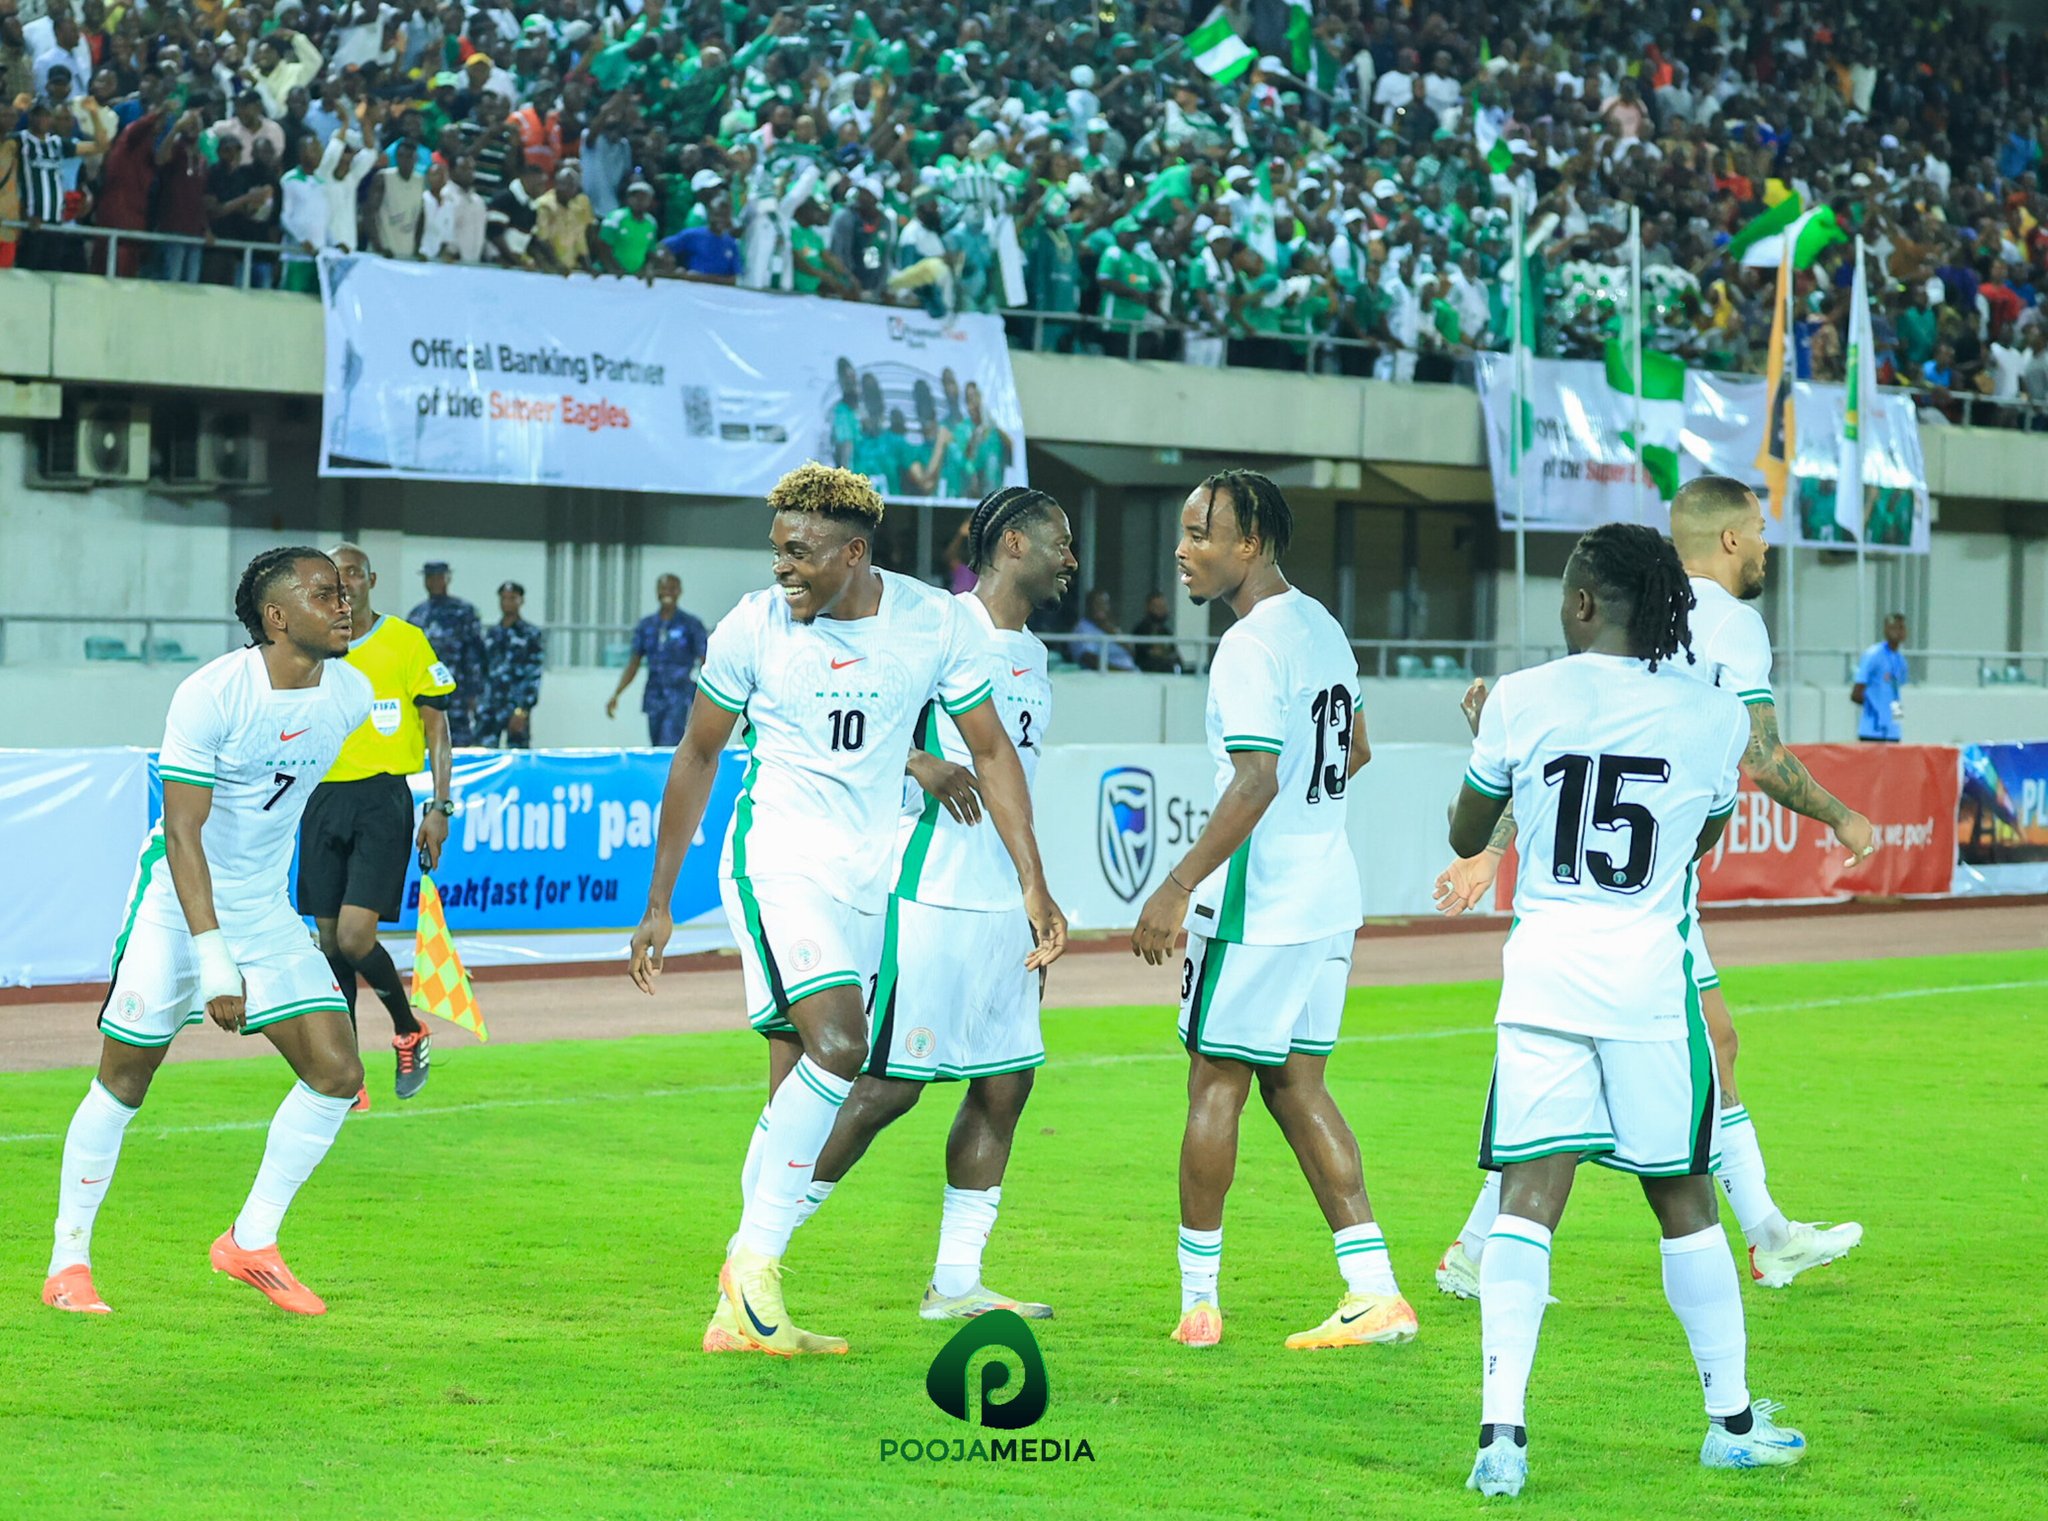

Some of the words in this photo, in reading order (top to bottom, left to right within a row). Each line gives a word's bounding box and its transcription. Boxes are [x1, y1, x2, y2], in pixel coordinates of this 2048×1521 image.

[411, 338, 493, 372] Offical
[498, 346, 588, 384] Banking
[417, 386, 440, 416] of
[447, 390, 483, 418] the
[560, 395, 631, 432] Eagles
[373, 701, 397, 711] FIFA
[828, 709, 866, 752] 10
[1017, 710, 1034, 748] 2
[1306, 683, 1354, 804] 13
[262, 771, 296, 811] 7
[597, 799, 706, 861] pa
[1543, 753, 1671, 895] 15
[407, 876, 528, 912] Beakfast
[535, 875, 570, 910] for
[578, 874, 618, 902] You
